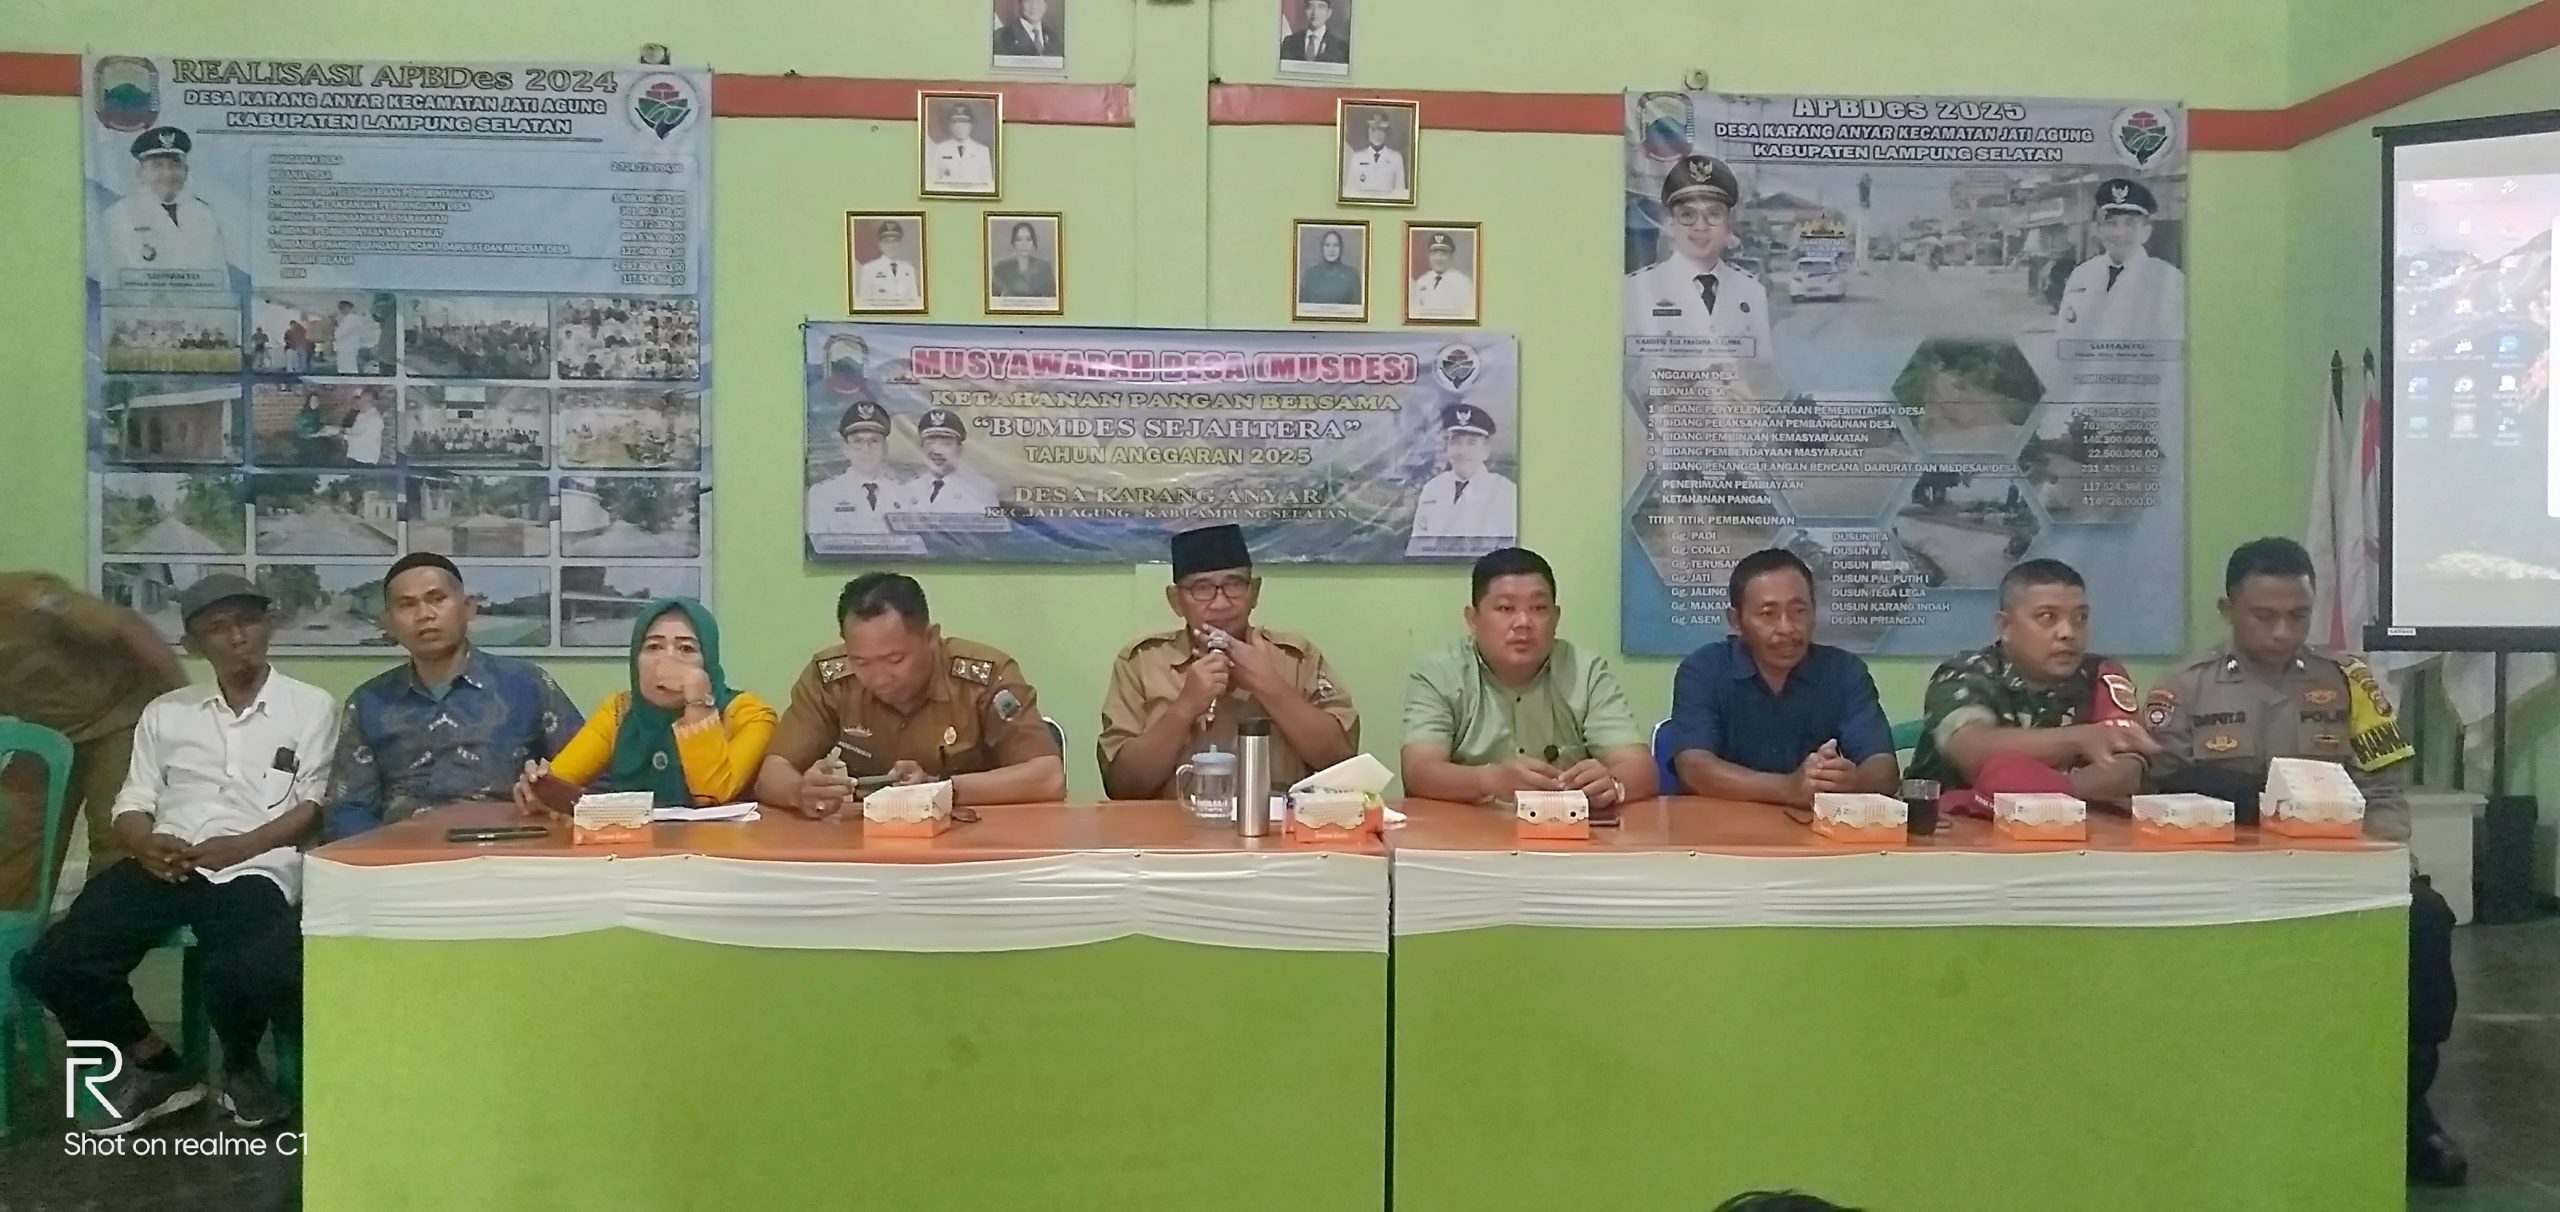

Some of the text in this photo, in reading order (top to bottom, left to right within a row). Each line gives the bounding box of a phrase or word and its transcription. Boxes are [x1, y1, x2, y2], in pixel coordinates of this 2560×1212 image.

[173, 59, 618, 93] REALISASI APBDes 2024
[184, 90, 607, 114] DESA KARANG ANYAR KECAMATAN JATI AGUNG
[1793, 98, 2027, 122] APBDes 2025
[227, 112, 572, 134] KABUPATEN LAMPUNG SELATAN
[1715, 122, 2094, 143] DESA KARANG ANYAR KECAMATAN JATI AGUNG
[1753, 143, 2063, 162] KABUPATEN LAMPUNG SELATAN
[912, 347, 1419, 384] MUSYAWARAH DESA (MUSDES)
[1649, 371, 1709, 380] ANGGARAN
[1649, 387, 1725, 397] BELANJA DESA
[931, 390, 1402, 411] KETAHANAN PANGAN BERSAMA
[1662, 405, 1701, 414] BIDANG
[1705, 405, 1812, 415] PENYELENGGARAAN
[1814, 406, 1896, 415] PEMERINTAHAN
[1899, 406, 1926, 415] DESA
[973, 416, 1361, 440] “BUMDES SEJAHTERA”
[1662, 419, 1702, 428] BIDANG
[1705, 419, 1784, 428] PELAKSANAAN
[1786, 420, 1867, 429] PEMBANGUNAN
[1869, 420, 1898, 429] DESA
[1662, 432, 1702, 441] BIDANG
[1705, 433, 1769, 442] PEMBINAAN
[1771, 433, 1869, 443] KEMASYARAKATAN
[1025, 446, 1312, 465] TAHUN ANGGARAN 2025
[1662, 448, 1702, 456] BIDANG
[1705, 448, 1792, 457] PEMBERDAYAAN
[1794, 448, 1864, 458] MASYARAKAT
[1662, 462, 1702, 471] BIDANG
[1703, 462, 1808, 472] PENANGGULANGAN
[1809, 463, 1860, 472] BENCANA
[1864, 463, 1912, 472] DARURAT
[1915, 464, 1937, 472] DAN
[1991, 464, 2018, 473] DESA
[1662, 480, 1804, 489] PENERIMAAN PEMBIAYAAN
[1014, 487, 1322, 504] DESA KARANG ANYAR
[1662, 495, 1772, 505] KETAHANAN PANGAN
[1069, 507, 1130, 518] AGUNG
[1271, 508, 1348, 519] SELATAN
[1648, 516, 1795, 525] TITIK TITIK PEMBANGUNAN
[1691, 532, 1717, 540] PADI
[1832, 532, 1870, 541] DUSUN
[1881, 533, 1889, 541] A
[1691, 546, 1732, 554] COKLAT
[1832, 546, 1870, 555] DUSUN
[1881, 547, 1888, 555] A
[1691, 560, 1739, 568] TERUSAN
[1832, 561, 1869, 569] DUSUN
[1690, 573, 1711, 582] JATI
[1832, 574, 1869, 583] DUSUN
[1871, 575, 1890, 583] PAL
[1893, 575, 1923, 583] PUTIH
[1690, 587, 1727, 596] JALING
[1832, 588, 1926, 597] DUSUN TEGA LEGA
[1691, 601, 1731, 610] MAKAM
[1831, 603, 1950, 612] DUSUN KARANG INDAH
[1691, 615, 1721, 624] ASEM
[1831, 616, 1926, 625] DUSUN PRIANGAN
